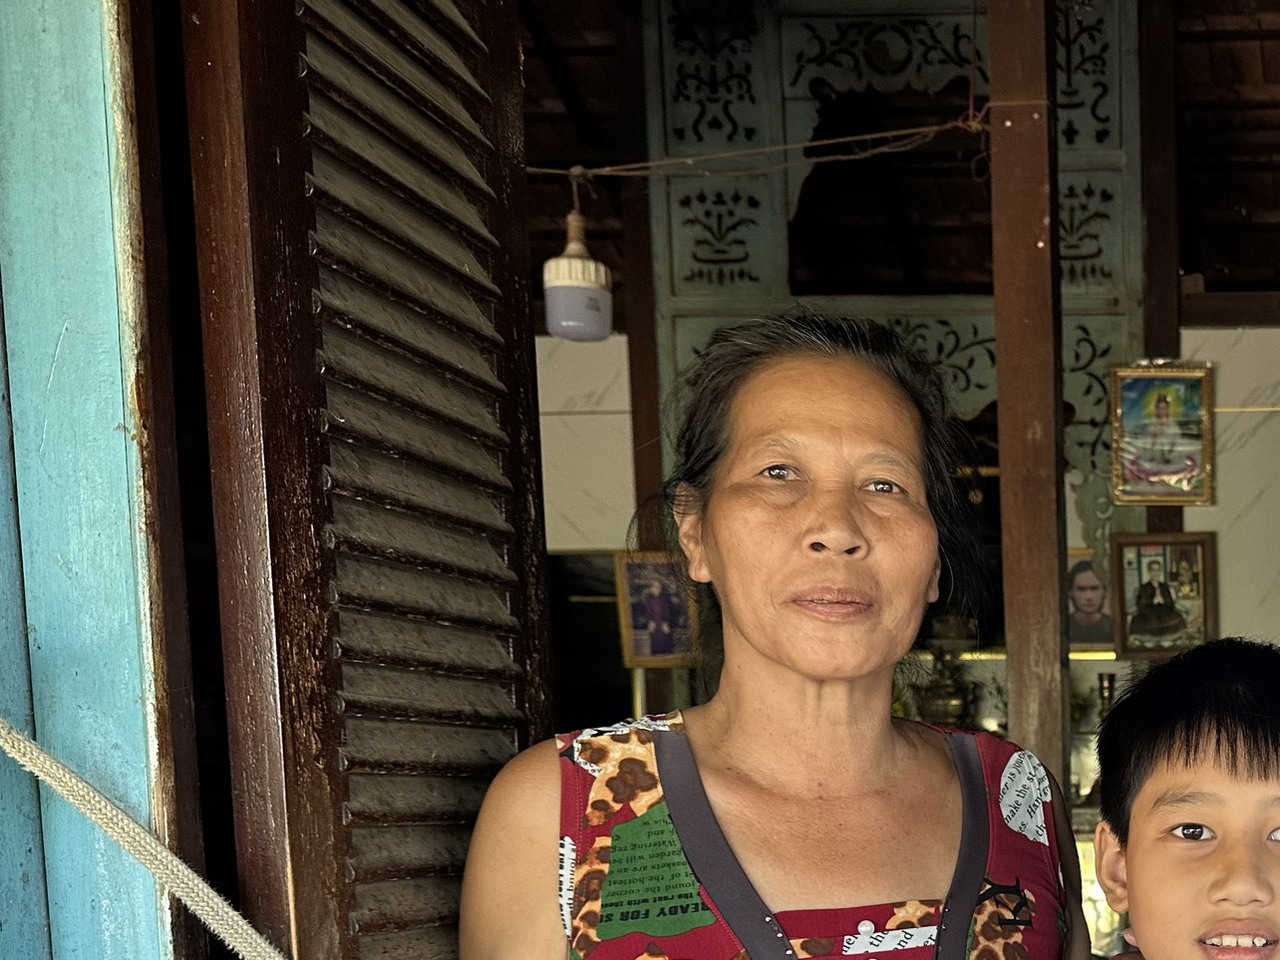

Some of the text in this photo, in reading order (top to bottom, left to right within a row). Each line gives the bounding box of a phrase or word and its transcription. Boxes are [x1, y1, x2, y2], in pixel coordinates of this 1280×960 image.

[632, 865, 648, 873] are
[608, 876, 645, 887] hottest
[648, 875, 665, 884] the
[605, 888, 640, 899] corner
[643, 886, 661, 895] the
[619, 909, 650, 921] FOR
